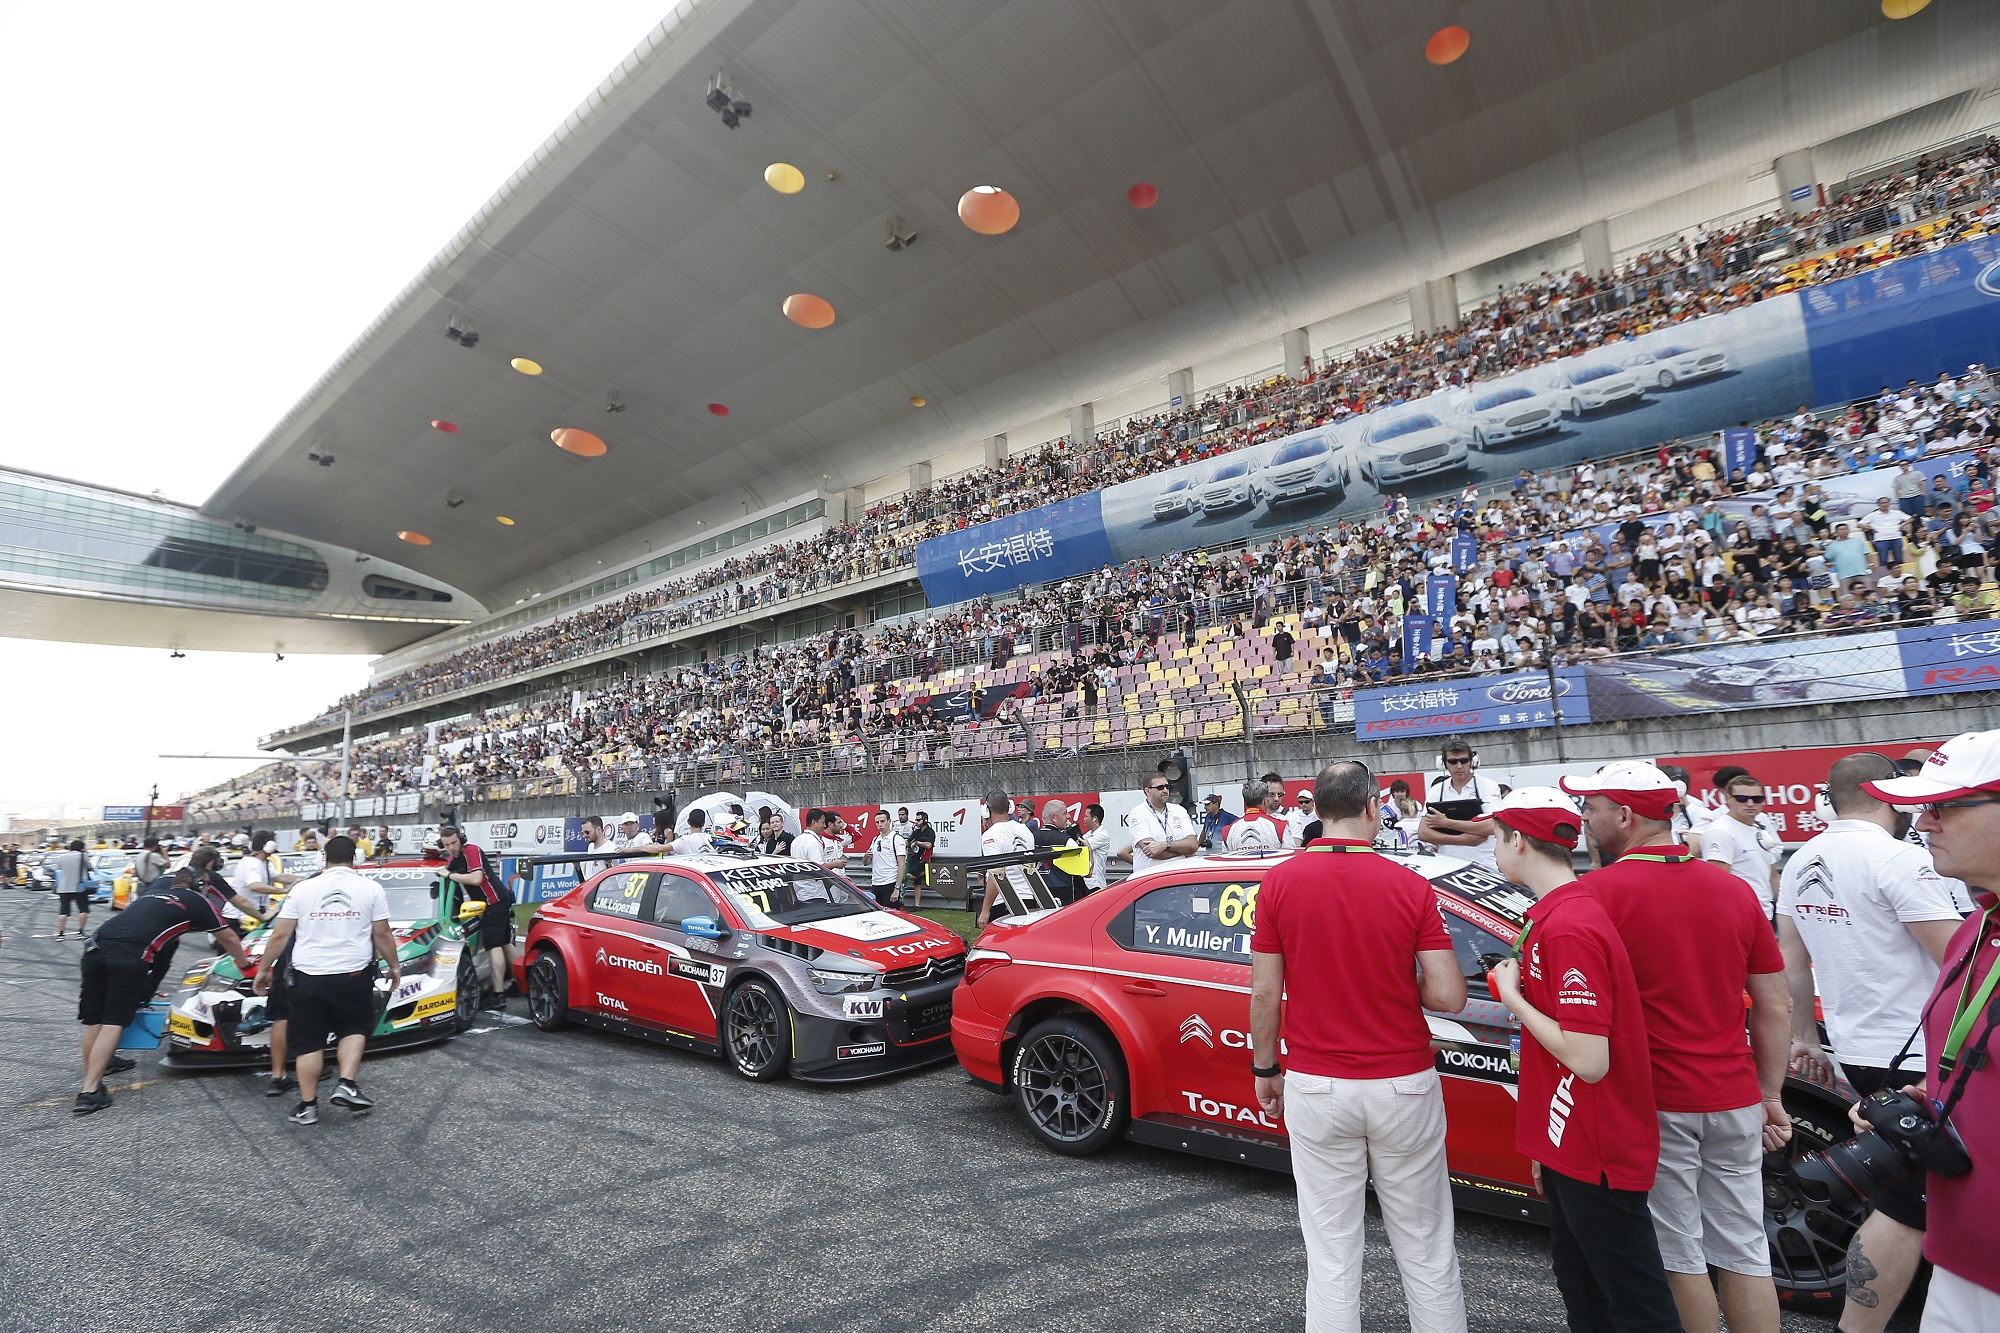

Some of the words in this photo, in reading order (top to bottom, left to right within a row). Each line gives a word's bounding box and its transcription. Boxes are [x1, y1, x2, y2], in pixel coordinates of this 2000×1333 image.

[957, 527, 1055, 578] 长安福特
[1381, 687, 1459, 713] 长安福特
[1503, 682, 1552, 701] Ford
[1365, 711, 1482, 734] RACING
[933, 820, 956, 833] TIRE
[720, 862, 822, 881] KENWOOD
[541, 882, 555, 890] FIA
[623, 872, 650, 899] 37
[746, 877, 790, 892] López
[736, 891, 773, 917] 37
[880, 938, 951, 957] TOTAL
[1145, 924, 1161, 944] Y.
[1166, 927, 1233, 952] Muller
[678, 962, 709, 979] YOKOHAMA
[711, 967, 725, 984] 37
[400, 981, 422, 999] KW
[417, 997, 455, 1012] BARDAHL
[595, 991, 629, 1012] TOTAL
[850, 1001, 881, 1015] KW
[849, 1045, 883, 1055] YOKOHAMA
[1013, 1046, 1026, 1086] ADVAN
[1441, 1049, 1519, 1075] YOKOHA
[1181, 1090, 1278, 1129] TOTAL
[1474, 1182, 1528, 1197] CAUTION
